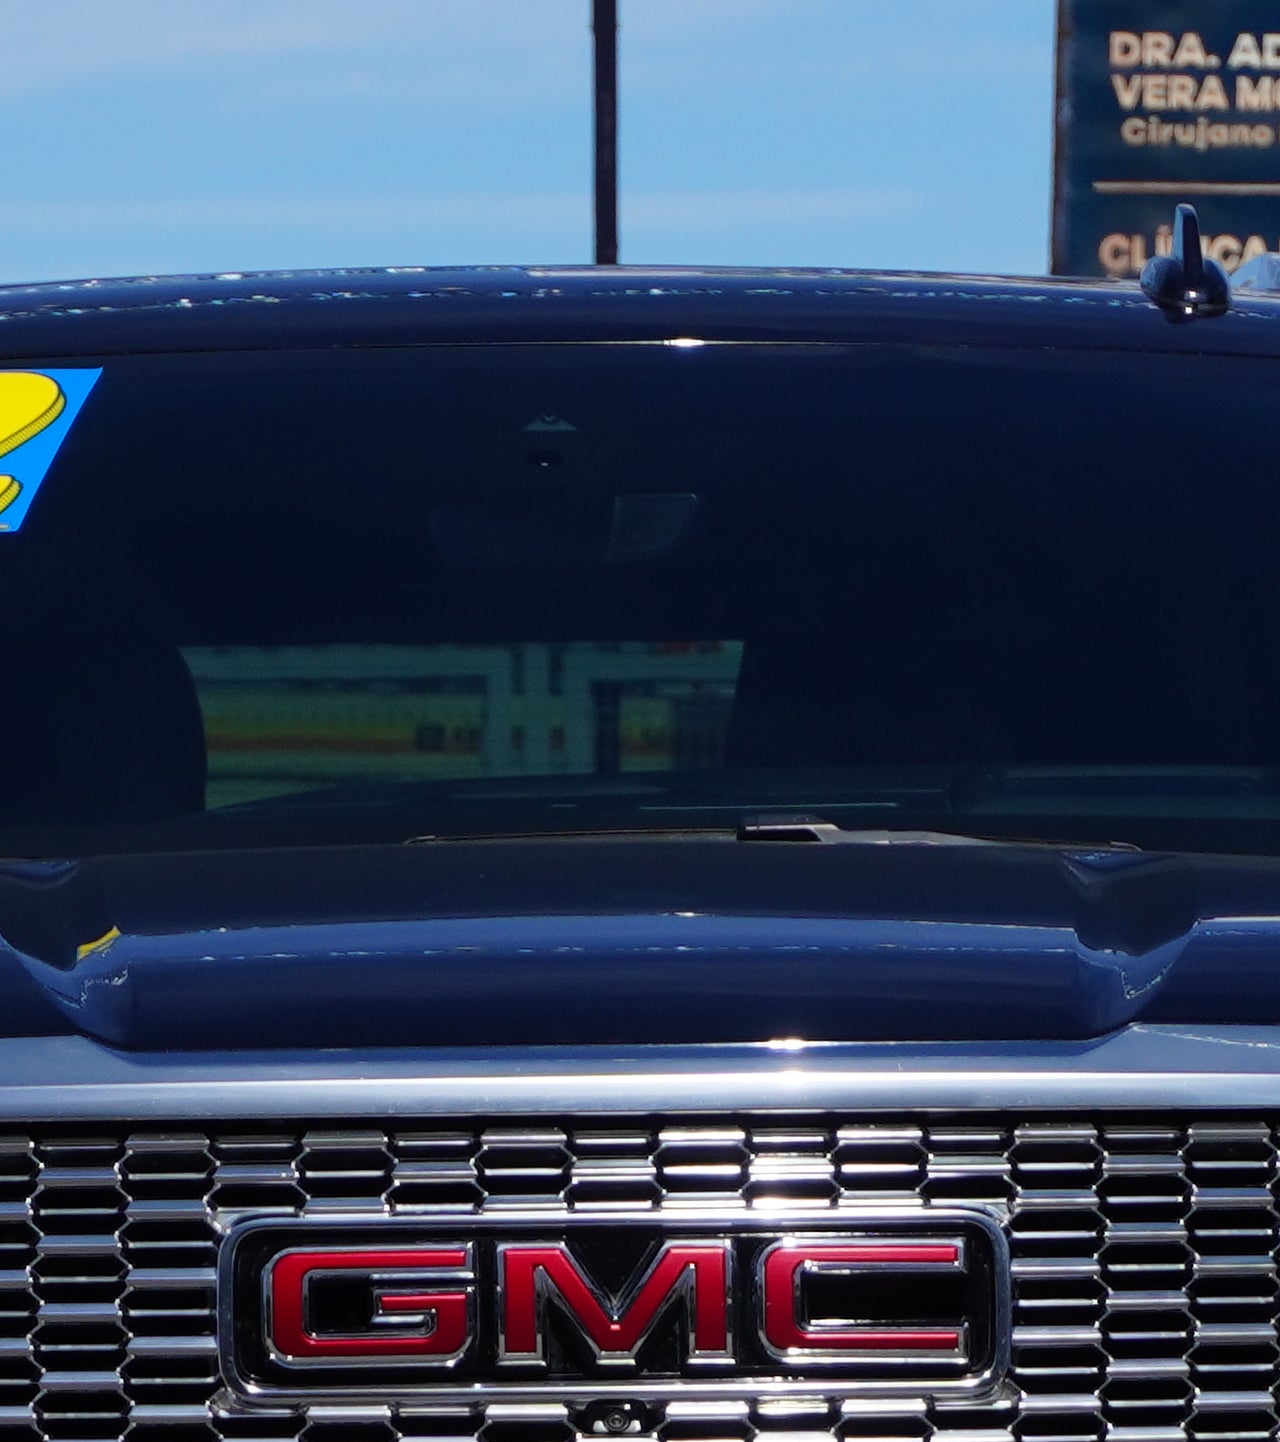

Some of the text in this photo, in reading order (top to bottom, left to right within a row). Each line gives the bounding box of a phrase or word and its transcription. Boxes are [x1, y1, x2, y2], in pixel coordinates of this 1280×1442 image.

[1109, 31, 1220, 69] DRA.
[1111, 73, 1229, 111] VERA
[1121, 115, 1275, 151] Cirujano
[1098, 224, 1268, 276] CLÍCA
[262, 1238, 968, 1367] GMC
